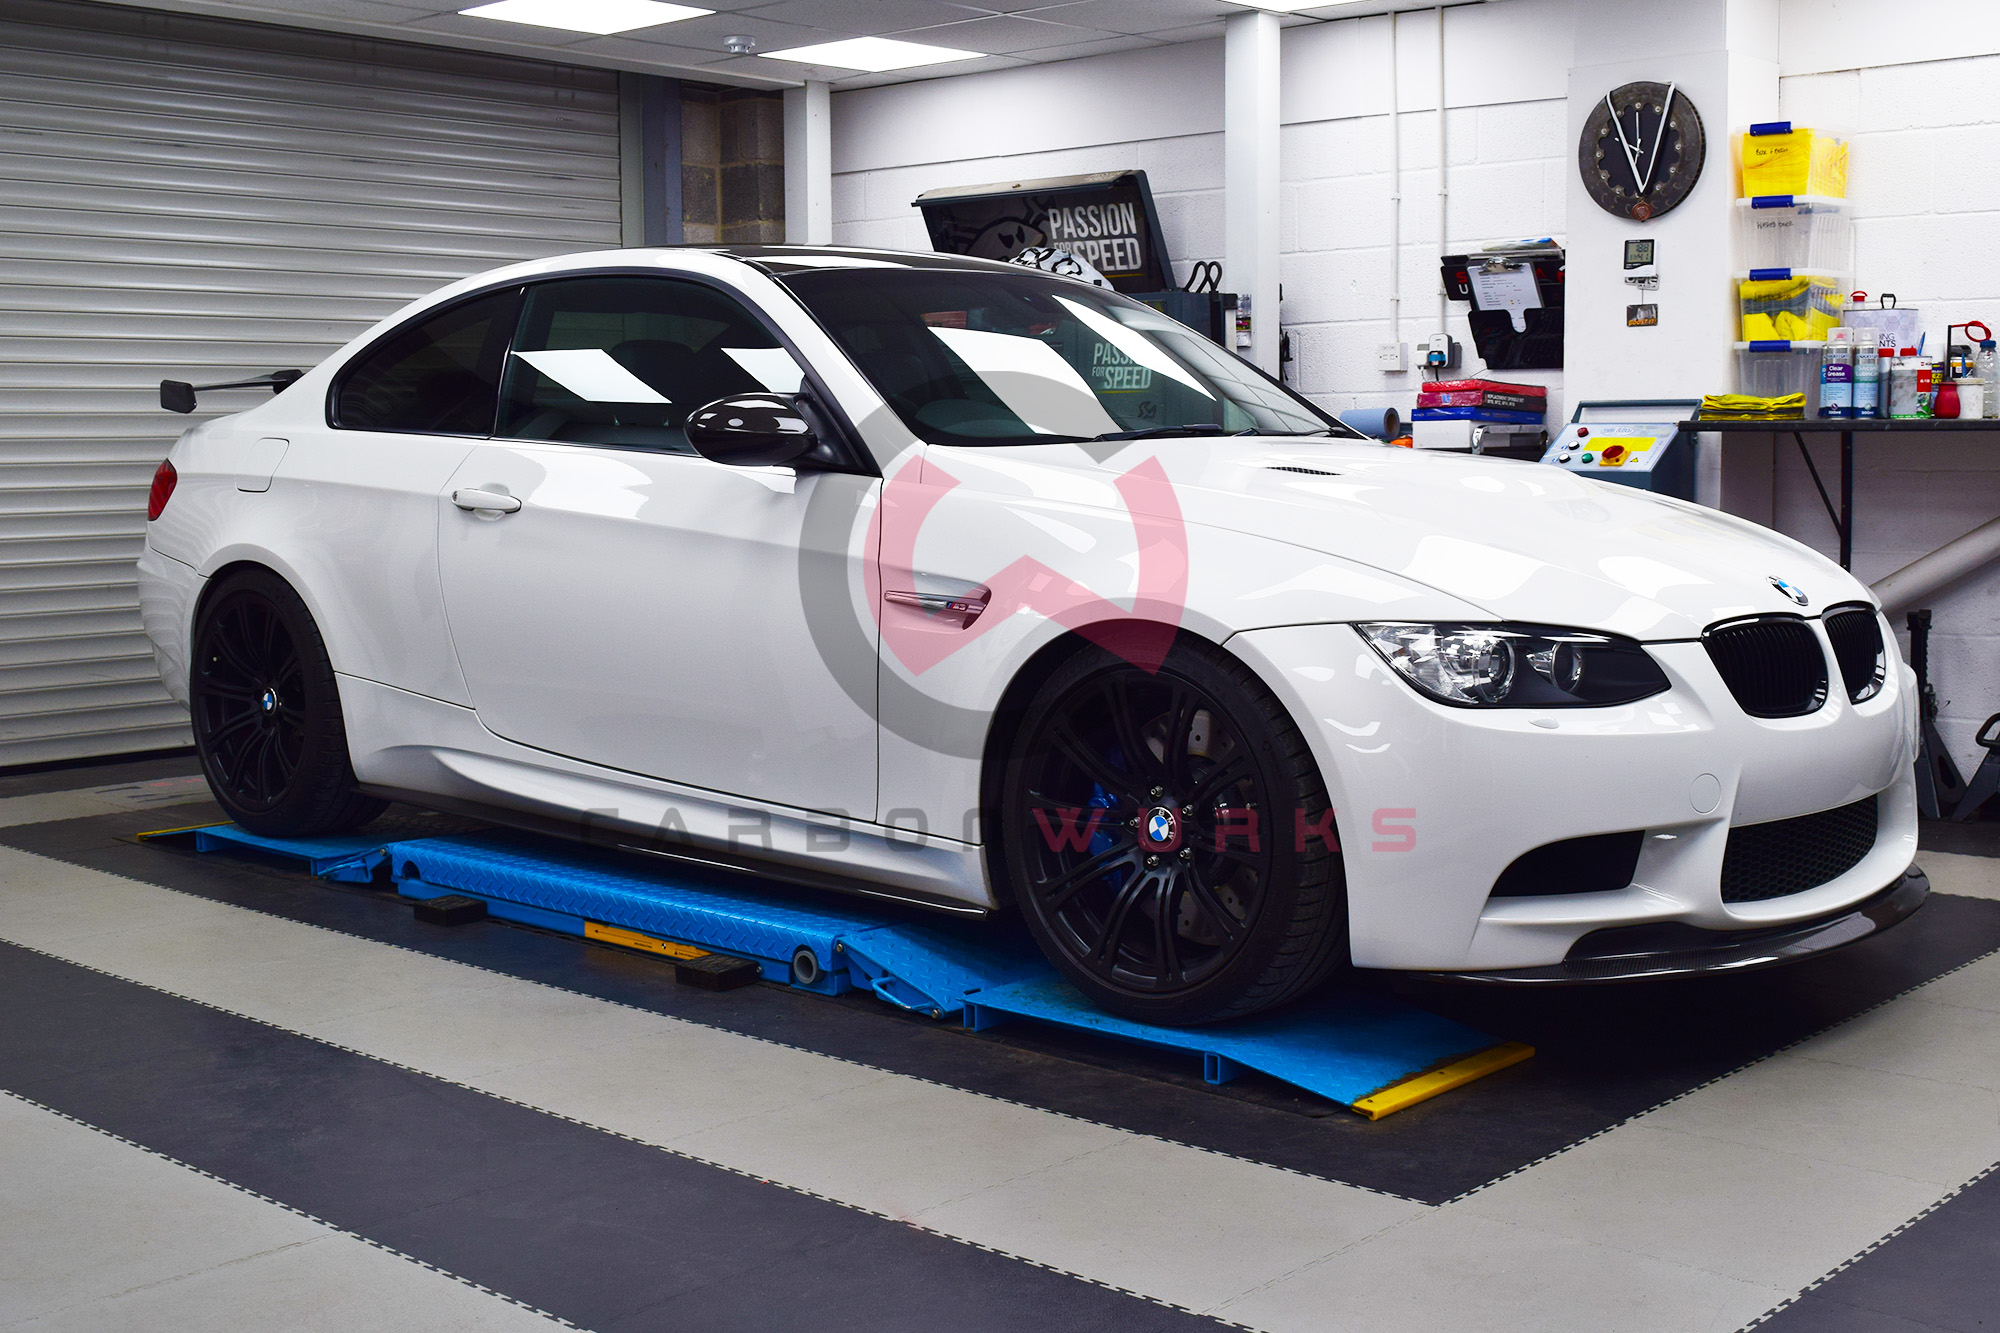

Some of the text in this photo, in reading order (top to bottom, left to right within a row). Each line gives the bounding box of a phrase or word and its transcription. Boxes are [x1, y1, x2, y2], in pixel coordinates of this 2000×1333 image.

[1048, 203, 1137, 240] PASSION
[1091, 366, 1152, 389] FOR SPEED
